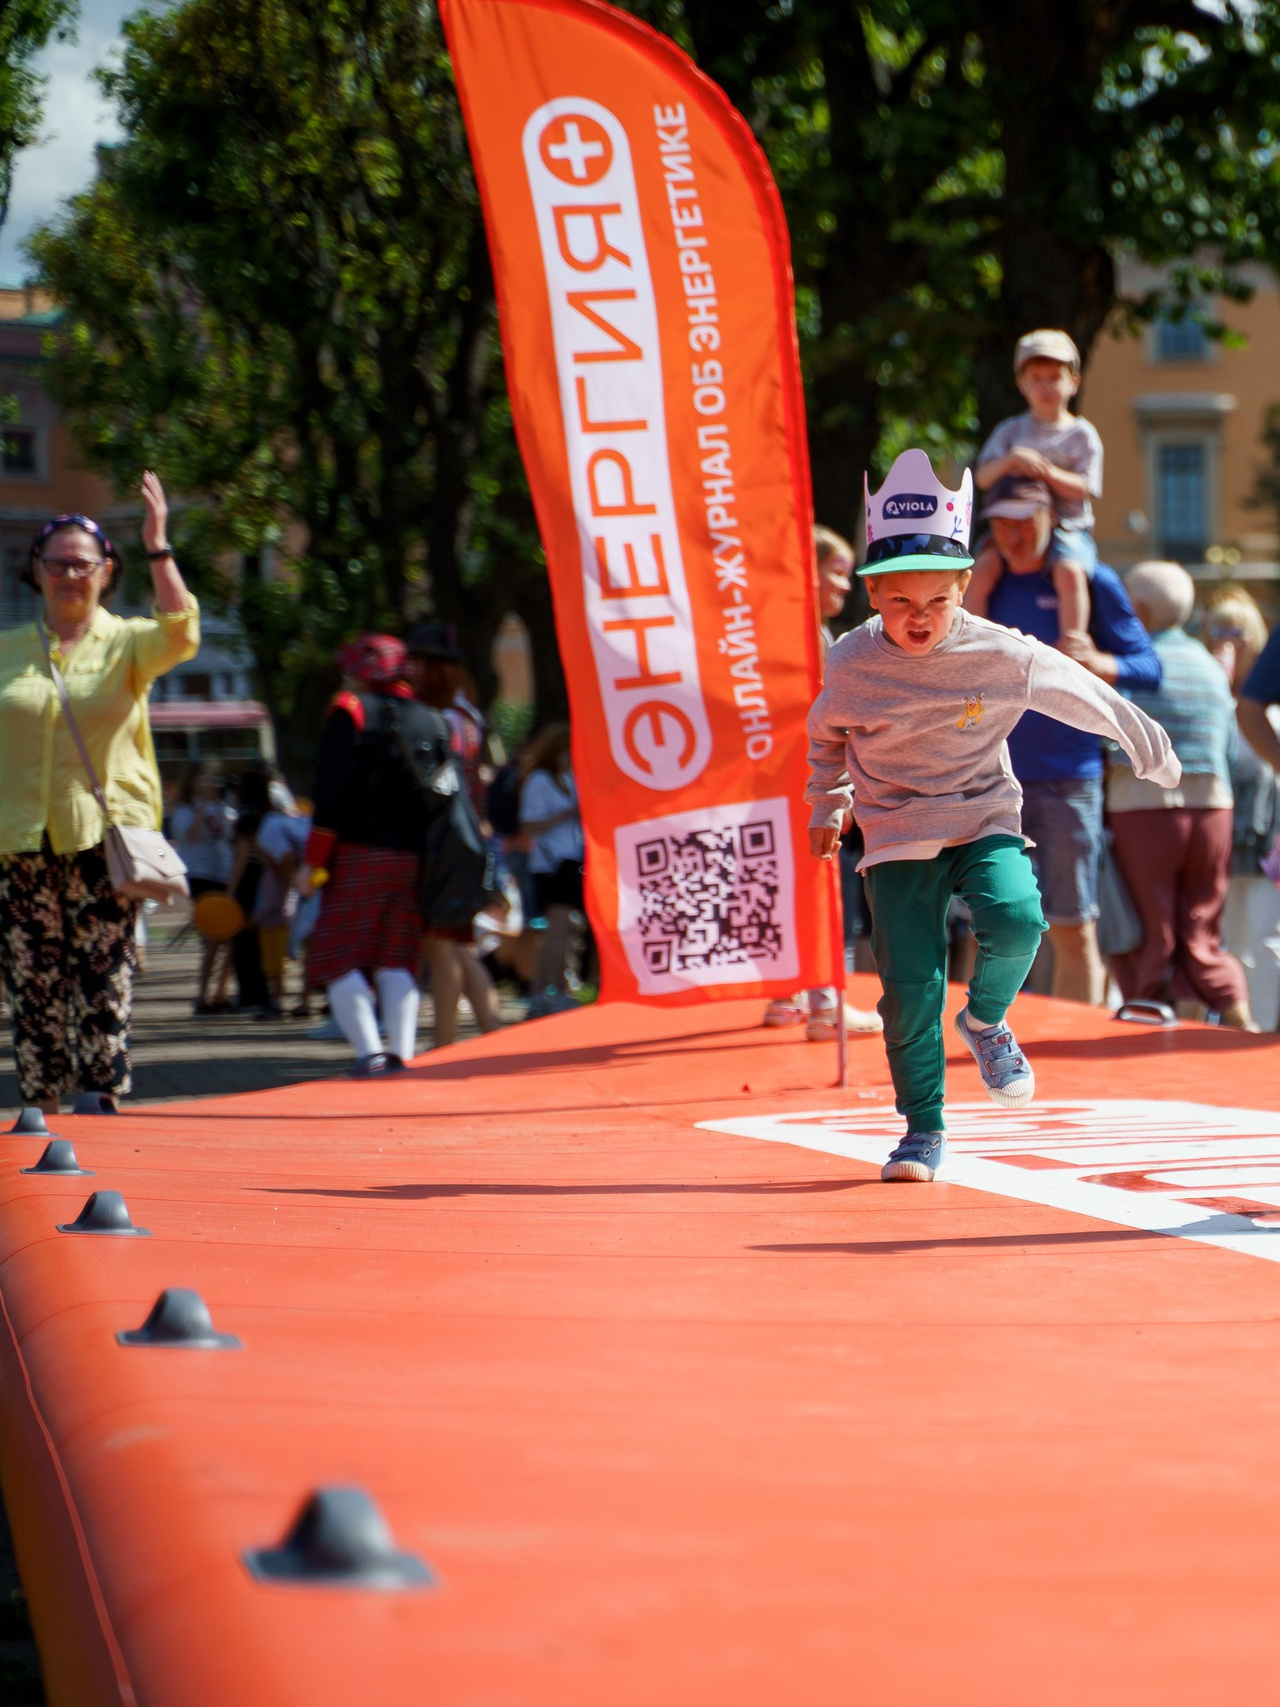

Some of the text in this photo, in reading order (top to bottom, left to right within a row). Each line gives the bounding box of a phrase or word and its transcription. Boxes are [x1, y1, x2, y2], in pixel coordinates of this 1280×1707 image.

[653, 102, 773, 761] ОНЛАЙН-ЖУРНАЛ ОБ ЭНЕРГЕТИКЕ
[899, 502, 935, 512] VIOLA
